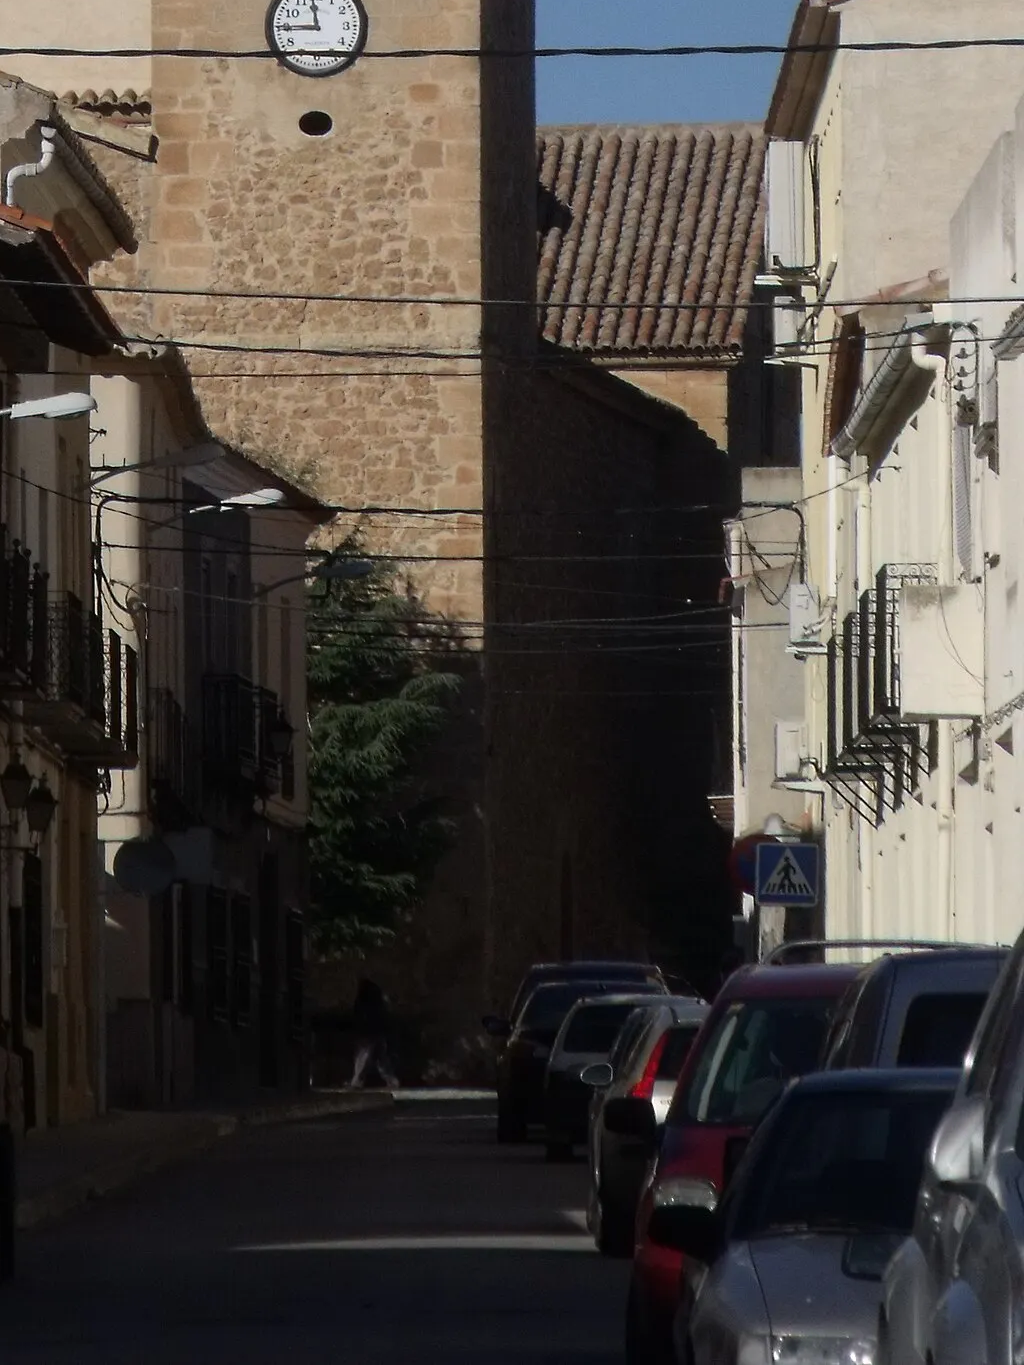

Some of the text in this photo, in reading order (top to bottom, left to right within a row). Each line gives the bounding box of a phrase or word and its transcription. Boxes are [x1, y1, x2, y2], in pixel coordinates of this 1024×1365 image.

[286, 9, 300, 18] 10
[338, 5, 346, 15] 2
[342, 21, 350, 31] 3
[287, 37, 294, 47] 8
[337, 36, 346, 46] 4
